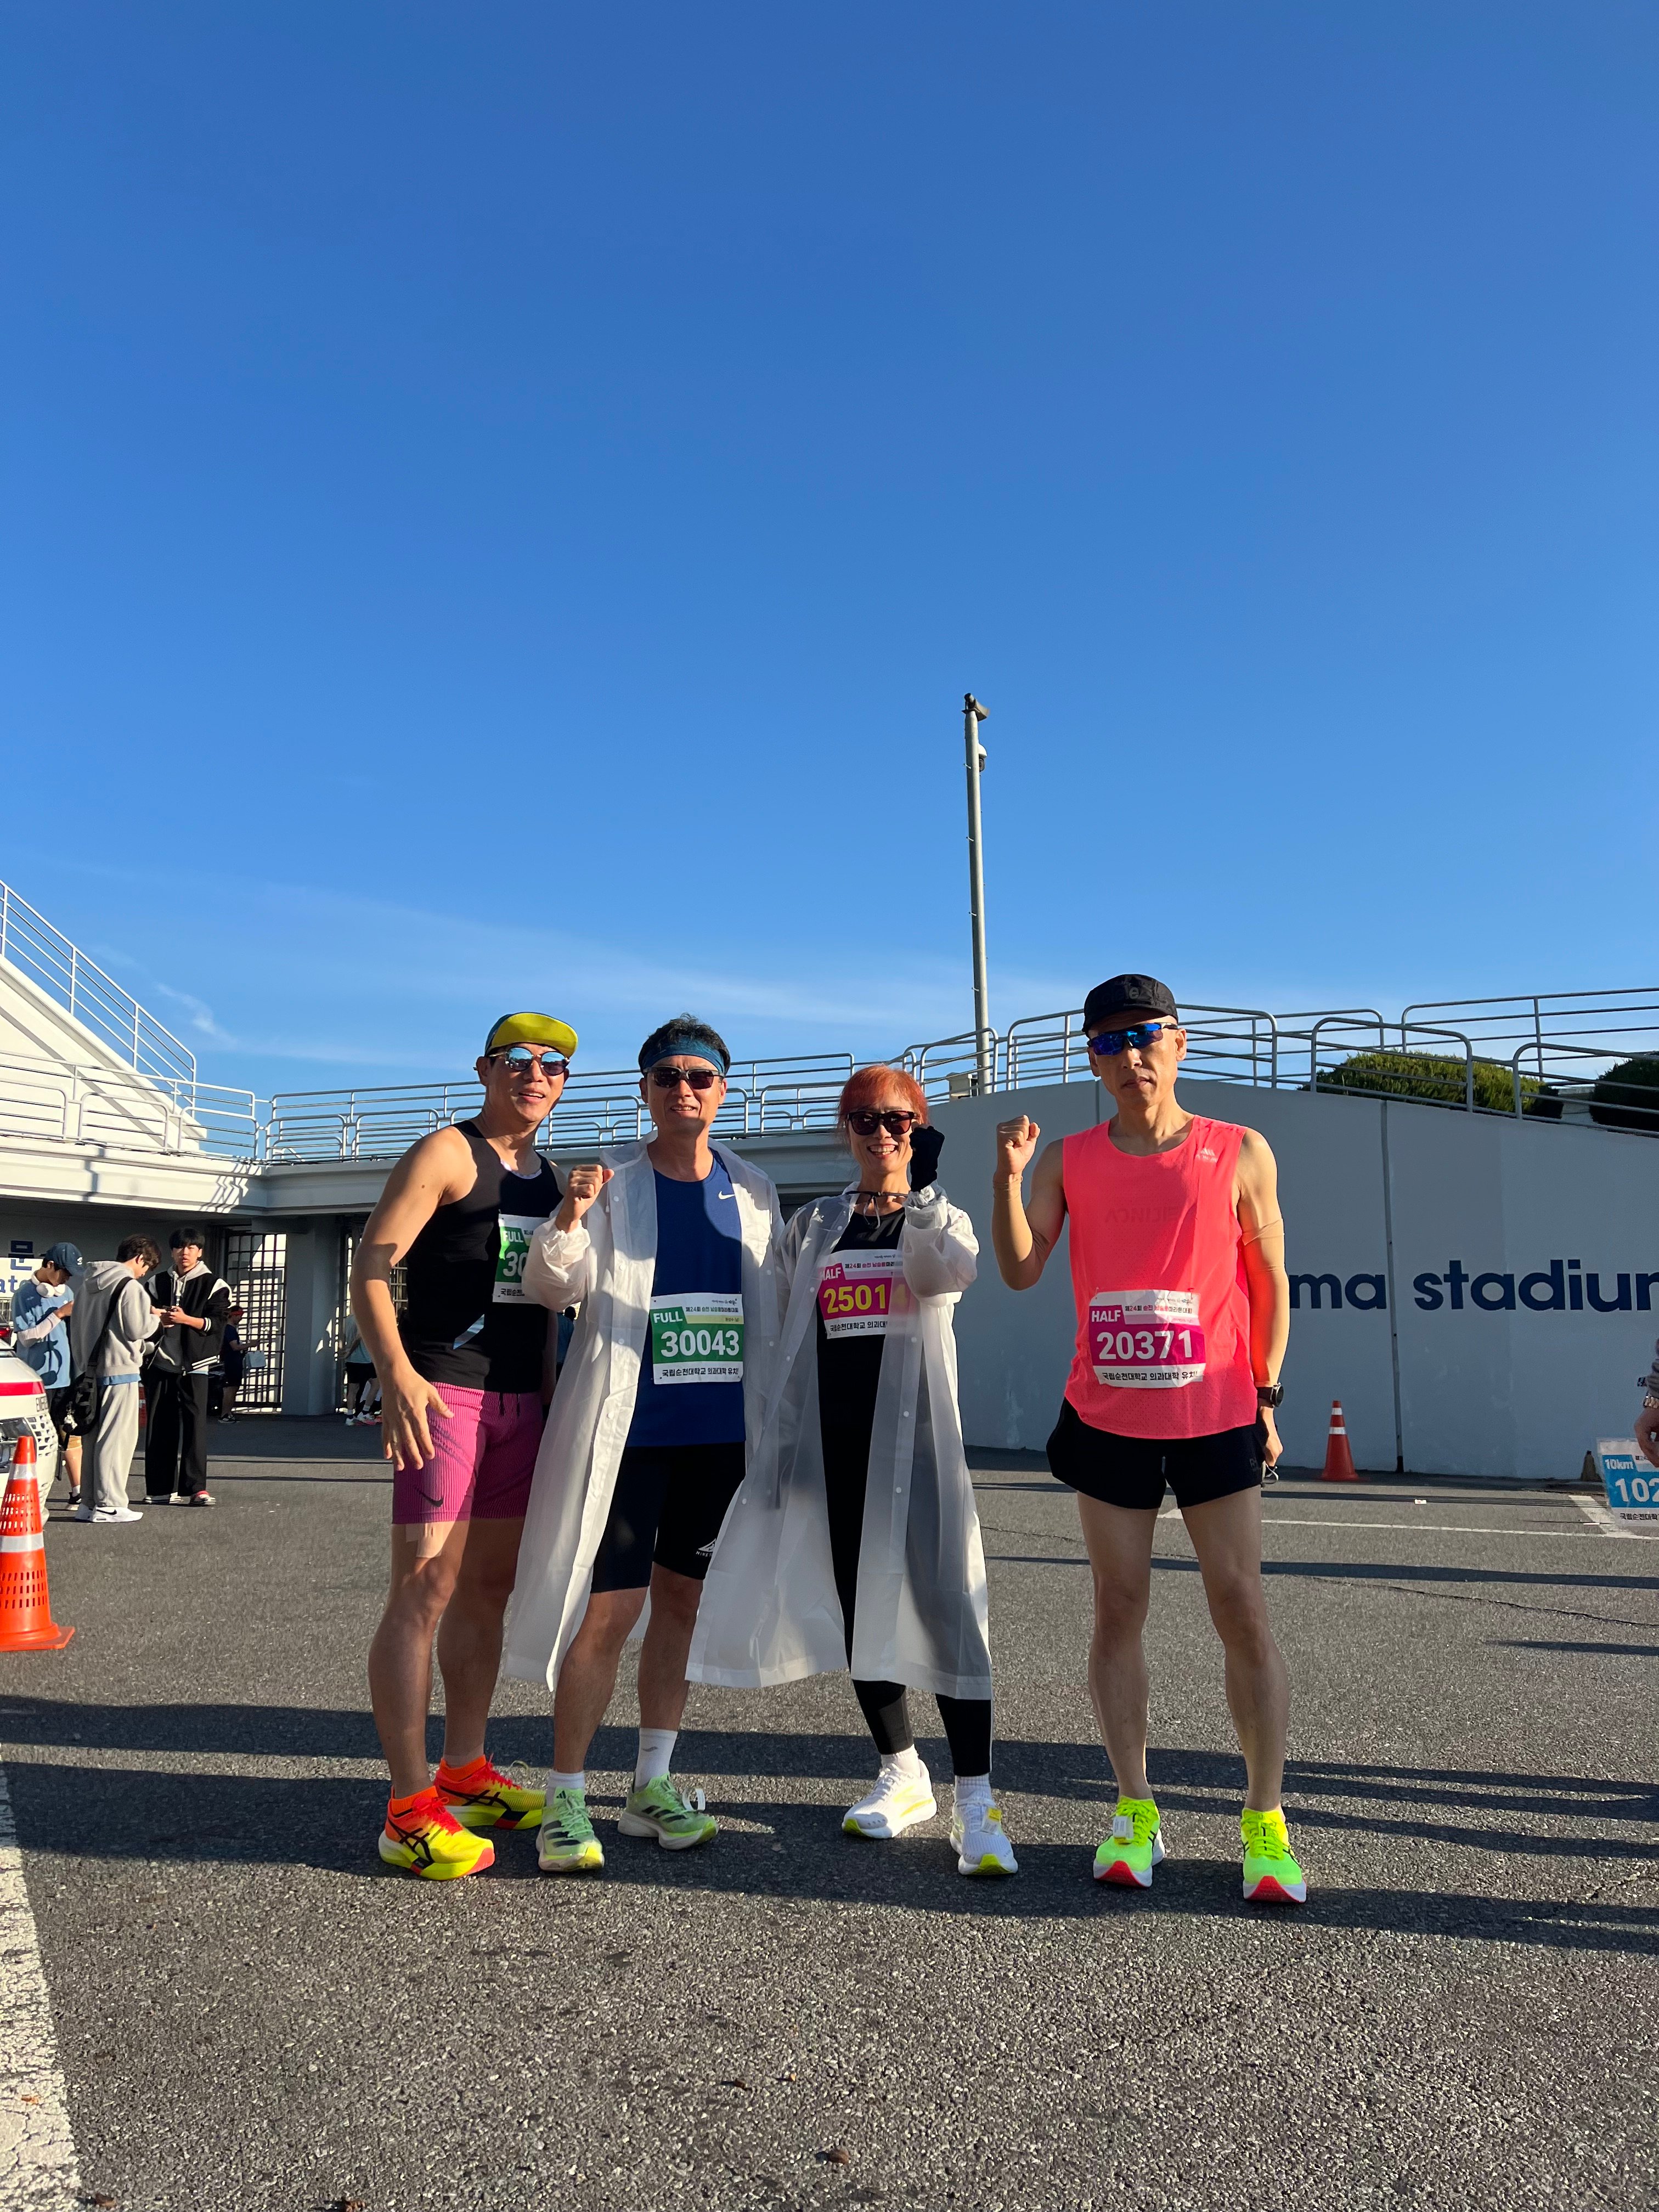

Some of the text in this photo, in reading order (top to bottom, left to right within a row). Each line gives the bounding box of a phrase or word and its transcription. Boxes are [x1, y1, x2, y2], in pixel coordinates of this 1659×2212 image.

[503, 1230, 524, 1243] FULL
[1289, 1273, 1387, 1311] ma
[653, 1311, 683, 1323] FULL
[1091, 1310, 1121, 1322] HALF
[661, 1330, 740, 1357] 30043
[1097, 1329, 1192, 1360] 20371
[662, 1368, 706, 1377] 국립순천대학교
[1102, 1372, 1147, 1381] 국립순천대학교
[1150, 1372, 1179, 1381] 의과대학
[1605, 1459, 1634, 1470] 10km
[1615, 1477, 1659, 1502] 102
